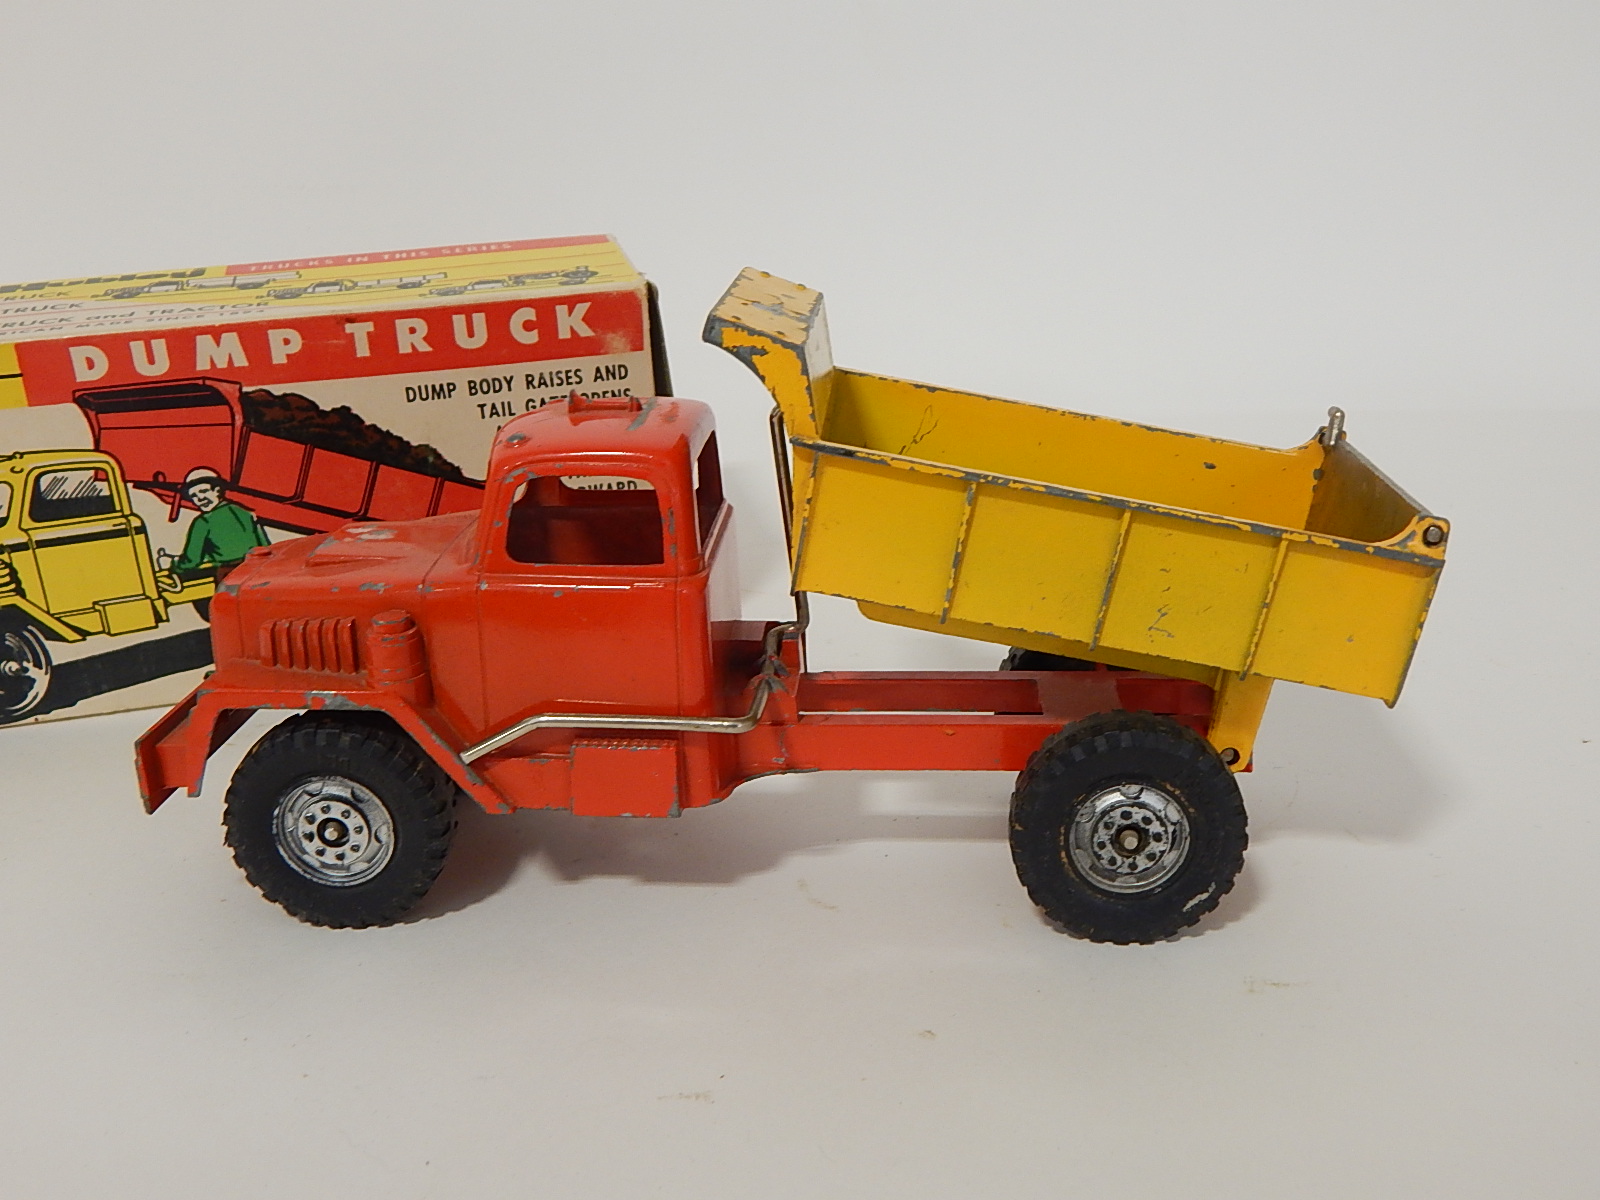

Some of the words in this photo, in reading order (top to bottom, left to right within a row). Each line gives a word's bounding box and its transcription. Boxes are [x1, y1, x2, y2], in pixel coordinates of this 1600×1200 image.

[382, 250, 429, 260] THIS
[441, 243, 512, 254] SERIES
[0, 291, 72, 301] RUCK
[2, 302, 84, 314] TRUCK
[0, 316, 76, 328] RUCK
[86, 311, 136, 321] and
[146, 302, 270, 316] TRACTOR
[68, 328, 303, 383] DUMP
[344, 301, 596, 358] TRUCK
[405, 382, 457, 403] DUMP
[467, 375, 514, 397] BODY
[525, 368, 583, 390] RAISES
[593, 363, 629, 383] AND
[477, 401, 516, 420] TAIL
[525, 395, 568, 412] GA
